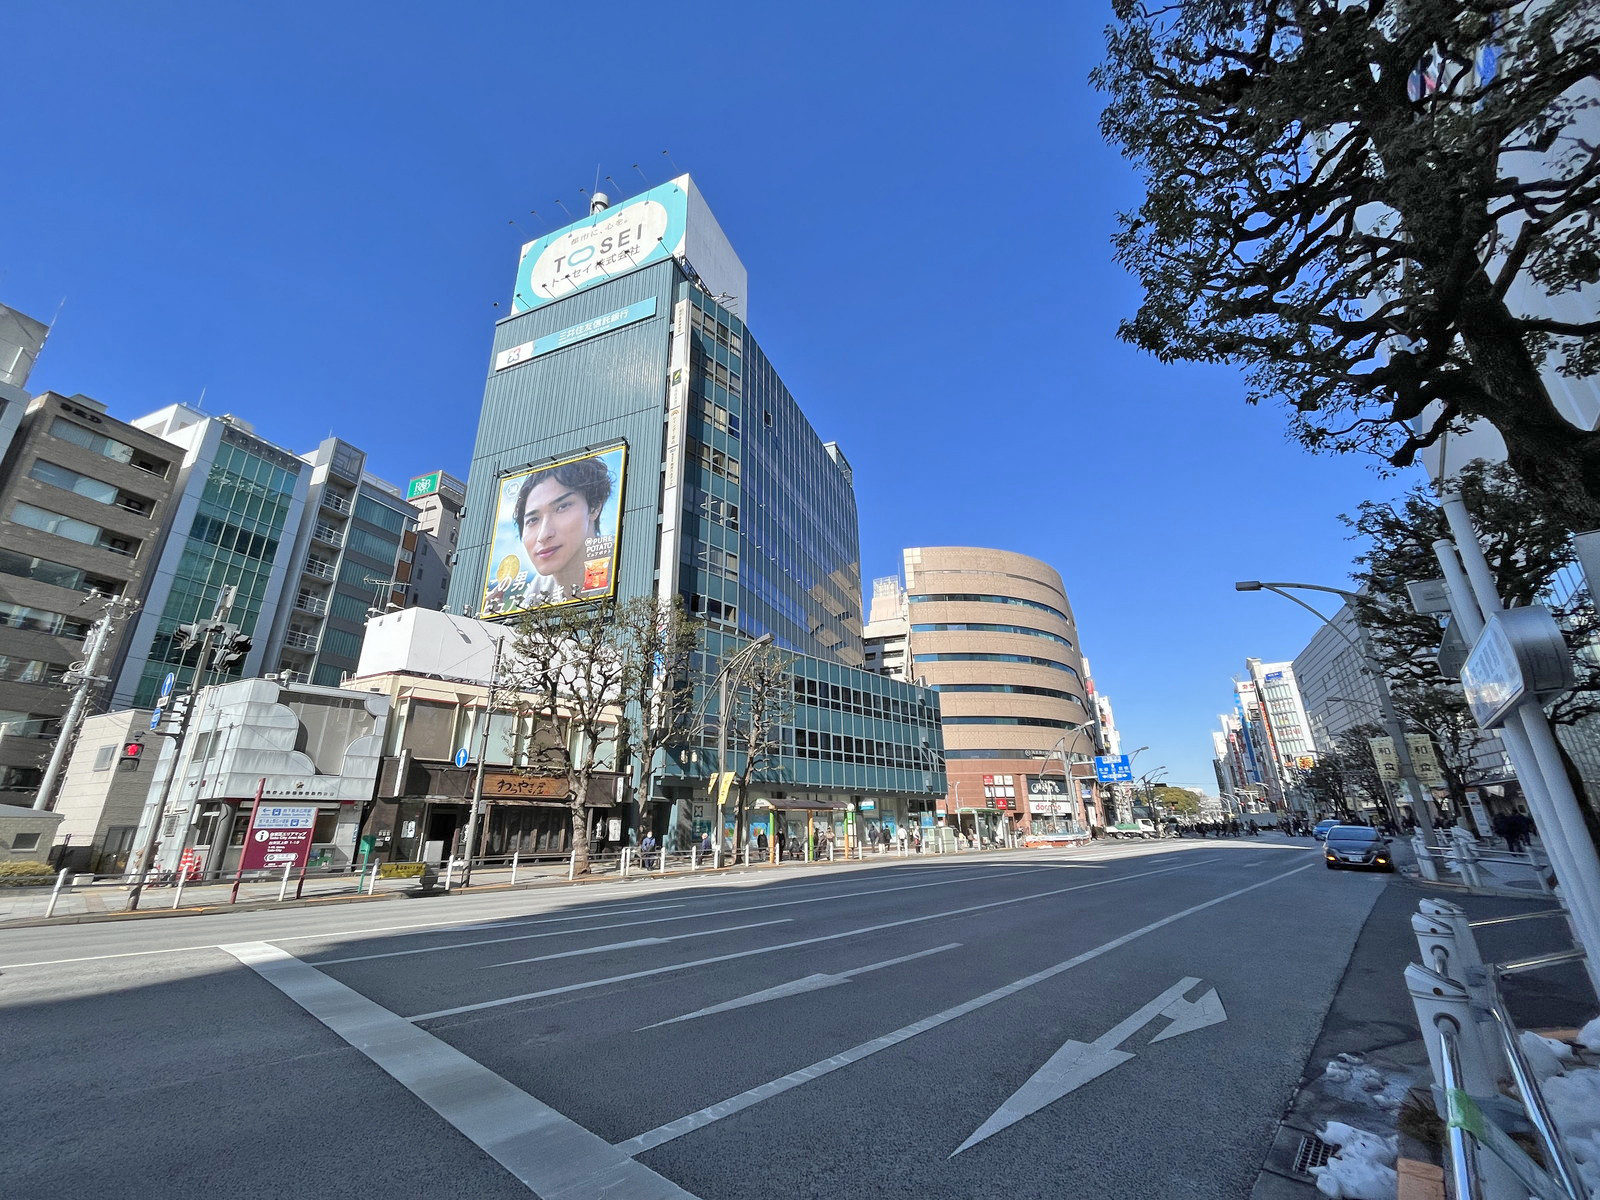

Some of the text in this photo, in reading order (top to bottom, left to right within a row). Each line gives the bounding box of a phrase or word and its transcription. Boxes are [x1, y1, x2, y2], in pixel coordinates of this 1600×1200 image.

[554, 223, 643, 273] TOSEI
[558, 309, 629, 342] 三井住友信託銀行
[414, 479, 431, 492] R&B
[593, 535, 613, 545] PURE
[586, 542, 613, 553] POTATO
